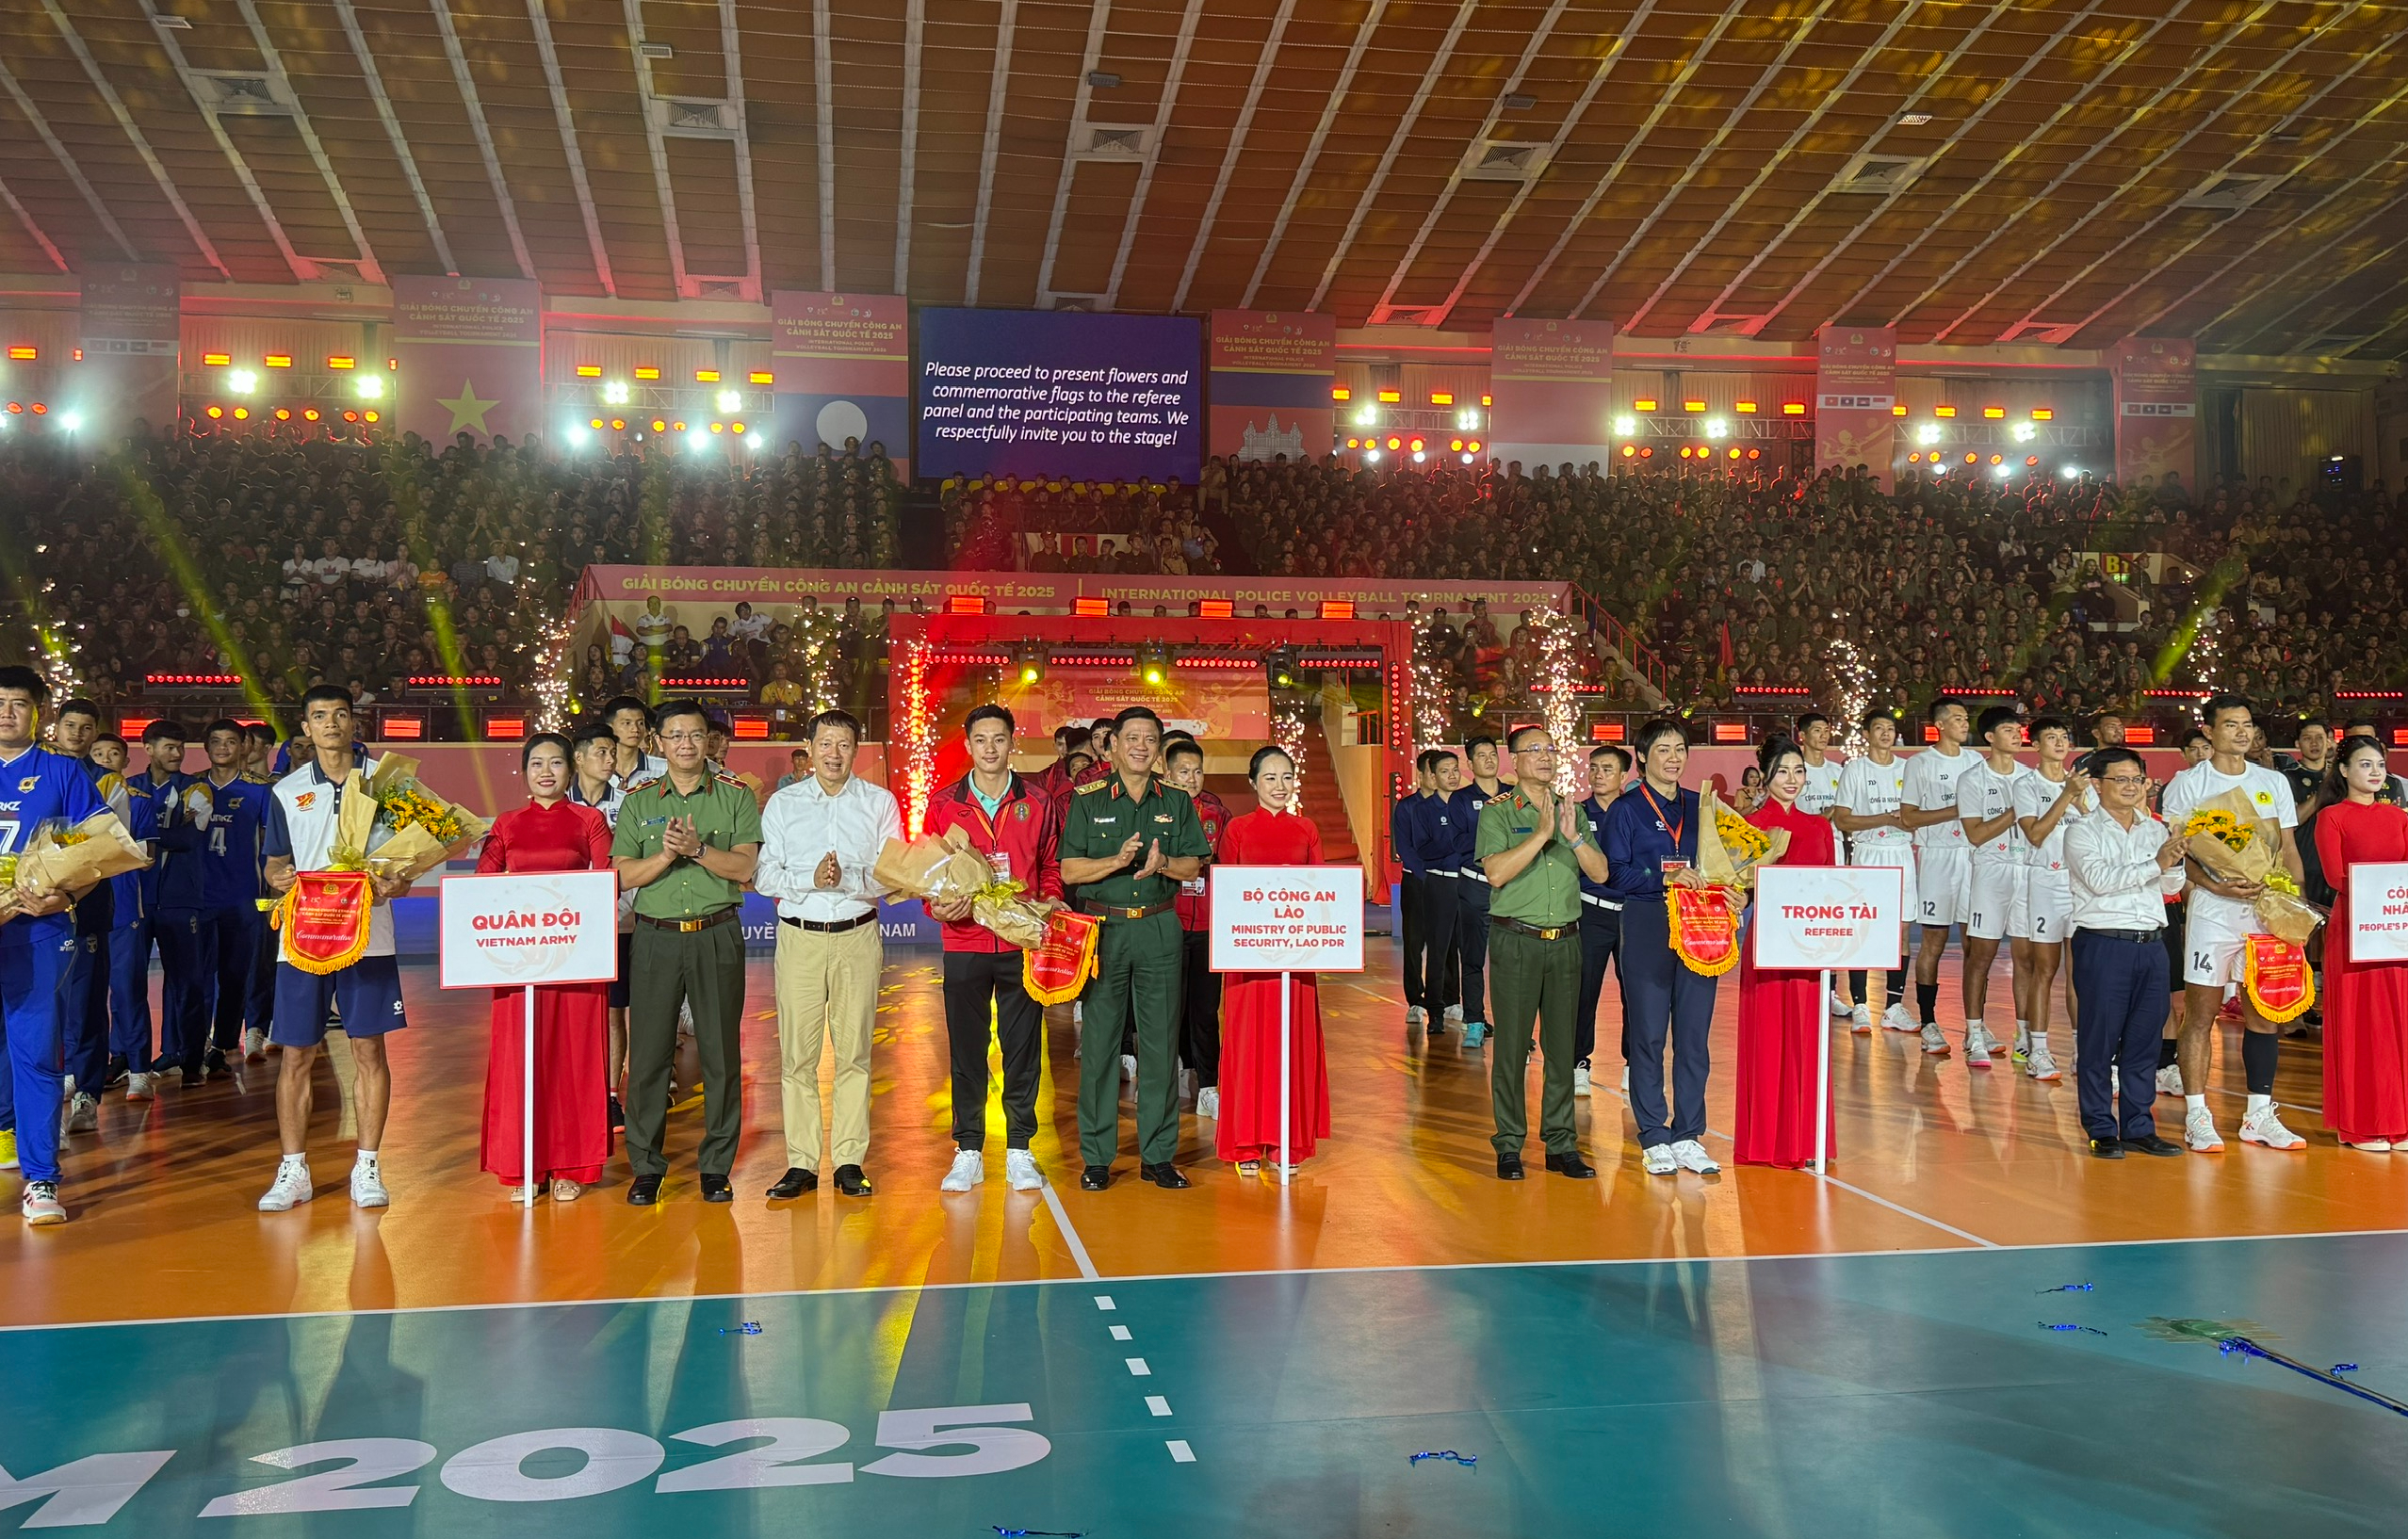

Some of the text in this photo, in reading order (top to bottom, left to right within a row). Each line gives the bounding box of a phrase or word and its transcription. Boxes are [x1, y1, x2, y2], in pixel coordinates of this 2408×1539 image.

[501, 316, 525, 324] 2025
[777, 316, 796, 326] GIẢI
[797, 317, 822, 327] BÓNG
[863, 320, 887, 330] CÔNG
[786, 326, 811, 336] CẢNH
[813, 328, 830, 337] SÁT
[872, 332, 894, 340] 2025
[925, 362, 1189, 386] Please proceed to present flowers and
[932, 383, 1181, 408] commemorative flags to the referee
[923, 403, 1189, 426] panel and the participating teams. We
[935, 424, 1178, 447] respectfully invite you to the stage!
[622, 573, 1056, 598] GIẢI BÓNG CHUYỀN CÔNG AN CẢNH SÁT QUỐC TẾ 2025
[1101, 588, 1228, 601] INTERNATIONAL
[1235, 590, 1292, 603] POLICE
[1295, 591, 1396, 603] VOLLEYBALL
[1512, 591, 1550, 604] 2025
[208, 827, 227, 857] 4
[1243, 887, 1336, 904] BỘ CÔNG AN
[2386, 885, 2408, 899] CÔ
[1274, 904, 1305, 919] LÀO
[1782, 901, 1878, 923] TRỌNG TÀI
[1922, 900, 1936, 917] 12
[472, 907, 581, 932] QUÂN ĐỘI
[1972, 912, 1982, 930] 11
[2036, 916, 2046, 934] 2
[879, 923, 916, 938] NAM
[1231, 924, 1347, 934] MINISTRY OF PUBLIC
[1804, 928, 1854, 936] REFEREE
[476, 934, 578, 948] VIETNAM ARMY
[1233, 938, 1345, 949] SECURITY, LAO PDR
[2193, 950, 2213, 974] 14
[196, 1402, 1051, 1518] 2025
